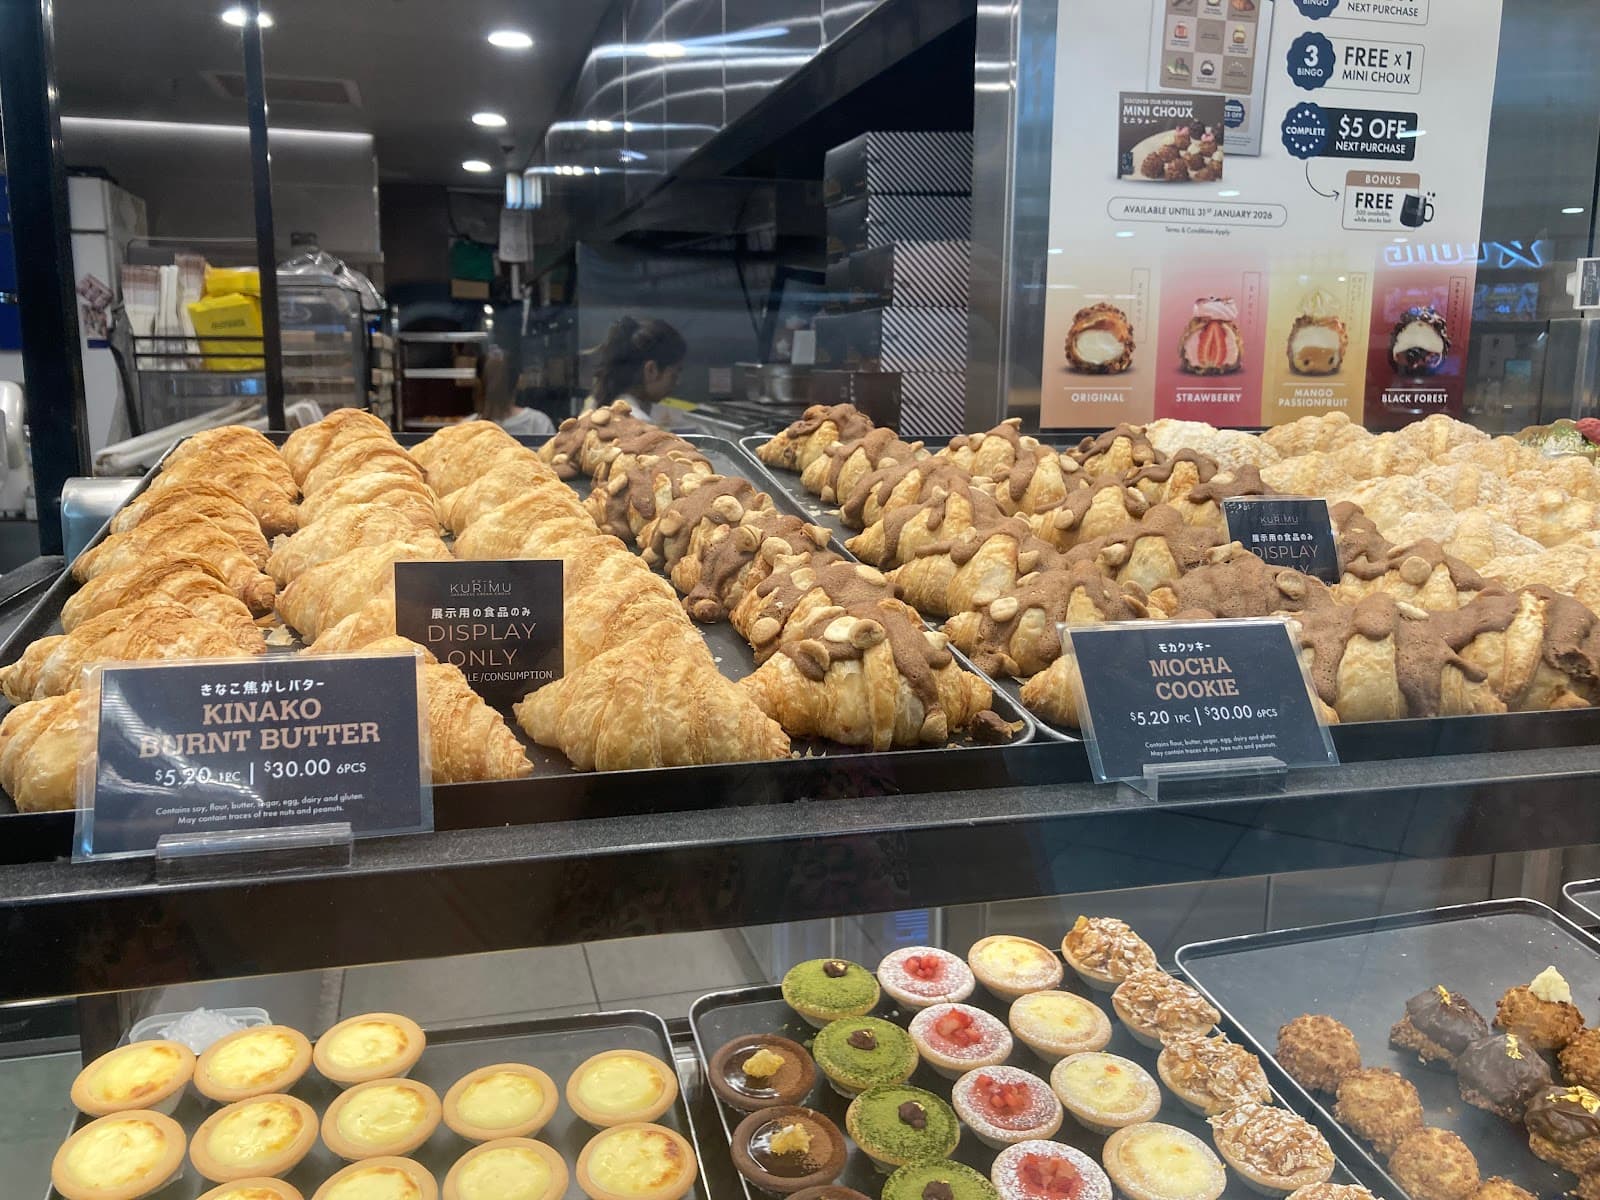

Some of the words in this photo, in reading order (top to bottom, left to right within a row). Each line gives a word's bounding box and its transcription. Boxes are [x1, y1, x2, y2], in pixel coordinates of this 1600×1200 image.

[1347, 2, 1371, 13] NEXT
[1372, 4, 1419, 17] PURCHASE
[1303, 44, 1319, 67] 3
[1344, 46, 1389, 68] FREE
[1297, 67, 1324, 77] BINGO
[1342, 70, 1368, 82] MINI
[1371, 71, 1411, 85] CHOUX
[1123, 105, 1150, 116] MINI
[1152, 106, 1193, 118] CHOUX
[1285, 126, 1326, 137] COMPLETE
[1338, 114, 1363, 139] $5
[1368, 118, 1407, 139] OFF
[1335, 140, 1359, 151] NEXT
[1360, 142, 1406, 154] PURCHASE
[1365, 174, 1401, 185] BONUS
[1355, 192, 1394, 210] FREE
[1124, 205, 1167, 215] AVAILABLE
[1168, 207, 1196, 216] UNTILL
[1213, 208, 1251, 219] JANUARY
[1253, 209, 1273, 220] 2026
[1071, 393, 1125, 403] ORIGINAL
[1175, 392, 1242, 403] STRAWBERRY
[1294, 388, 1334, 398] MANGO
[1381, 394, 1411, 404] BLACK
[1413, 394, 1448, 404] FOREST
[1278, 398, 1349, 408] PASSIONFRUIT
[1251, 544, 1318, 560] DISPLAY
[450, 582, 512, 594] KURIMU
[431, 606, 532, 620] 展示用の食品のみ
[428, 622, 537, 642] DISPLAY
[1158, 641, 1212, 653] モカクッキー
[447, 648, 518, 667] ONLY
[1148, 656, 1233, 677] MOCHA
[200, 679, 326, 697] きなこ焦がしバター
[1155, 678, 1240, 700] COOKIE
[202, 697, 322, 726] KINAKO
[1129, 709, 1170, 726] $5.20
[1173, 713, 1192, 724] 1PC
[1204, 705, 1253, 721] $30.00
[1256, 708, 1278, 718] 6PCS
[138, 730, 251, 759] BURNT
[259, 721, 381, 751] BUTTER
[154, 766, 212, 787] $5.20
[218, 771, 241, 783] 1PC
[263, 758, 331, 779] $30.00
[335, 761, 367, 775] 6PCS
[155, 806, 190, 816] Contains
[192, 805, 208, 814] soy,
[209, 802, 230, 811] flour,
[231, 801, 256, 810] butter,
[282, 799, 300, 807] egg,
[301, 795, 322, 804] dairy
[323, 793, 339, 802] and
[339, 792, 365, 803] gluten.
[177, 816, 197, 825] May
[198, 814, 227, 823] contain
[253, 810, 262, 818] of
[279, 808, 295, 816] nuts
[296, 806, 312, 814] and
[312, 805, 345, 815] peanuts.
